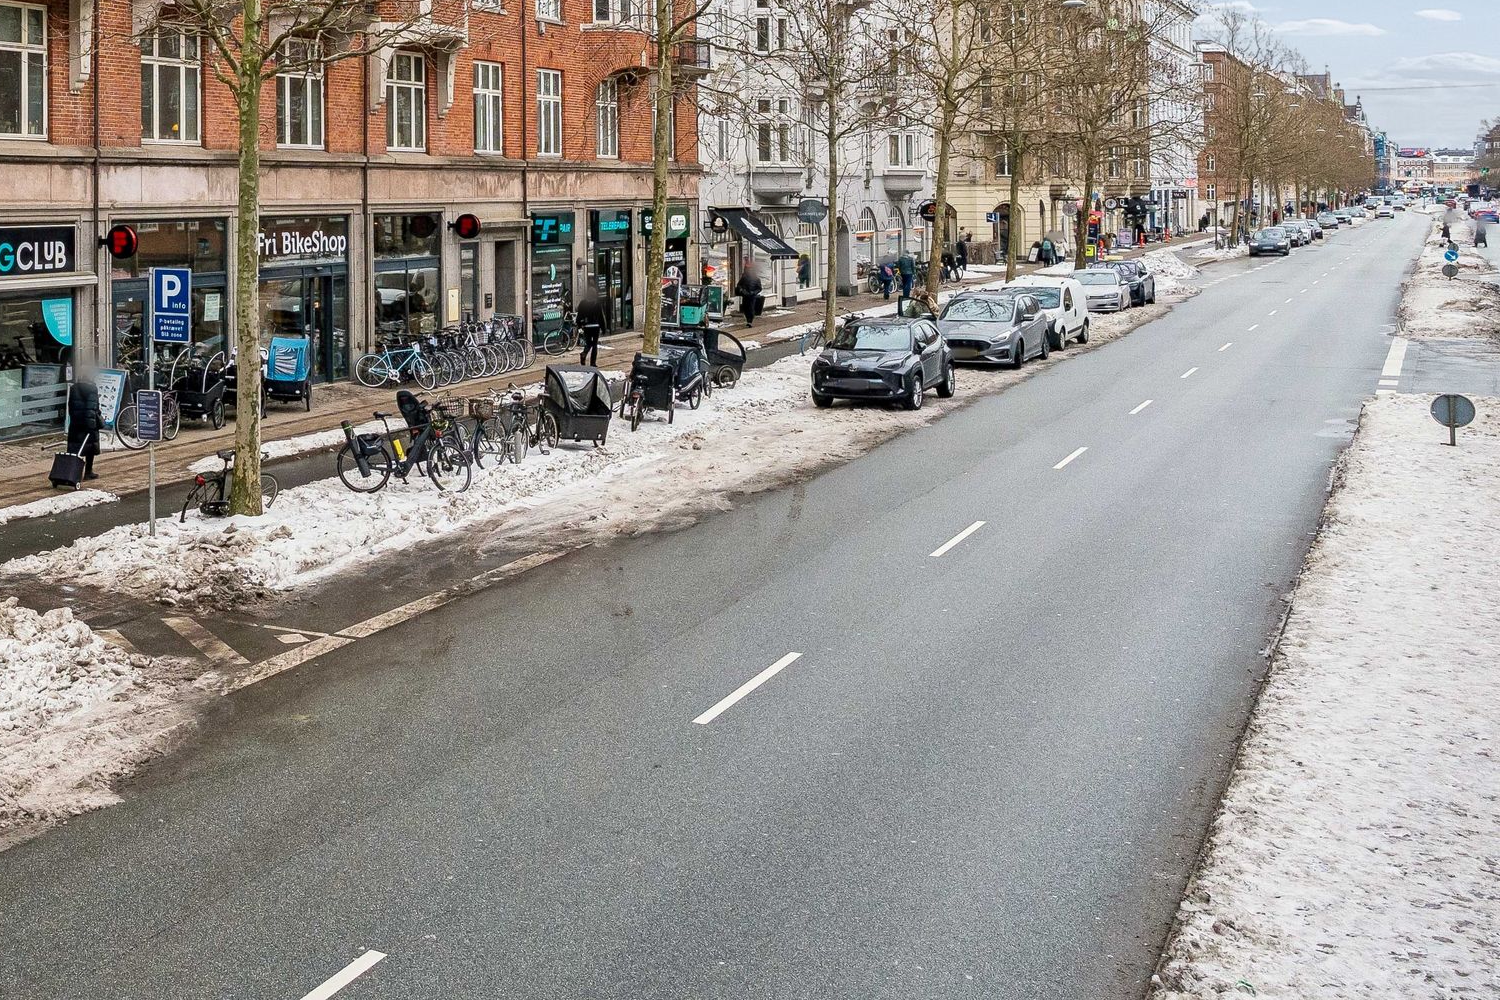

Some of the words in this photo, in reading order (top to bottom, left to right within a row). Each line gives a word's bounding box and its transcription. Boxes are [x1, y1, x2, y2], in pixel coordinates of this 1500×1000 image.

[257, 232, 277, 256] Fri
[281, 230, 347, 257] BikeShop
[162, 274, 181, 308] P
